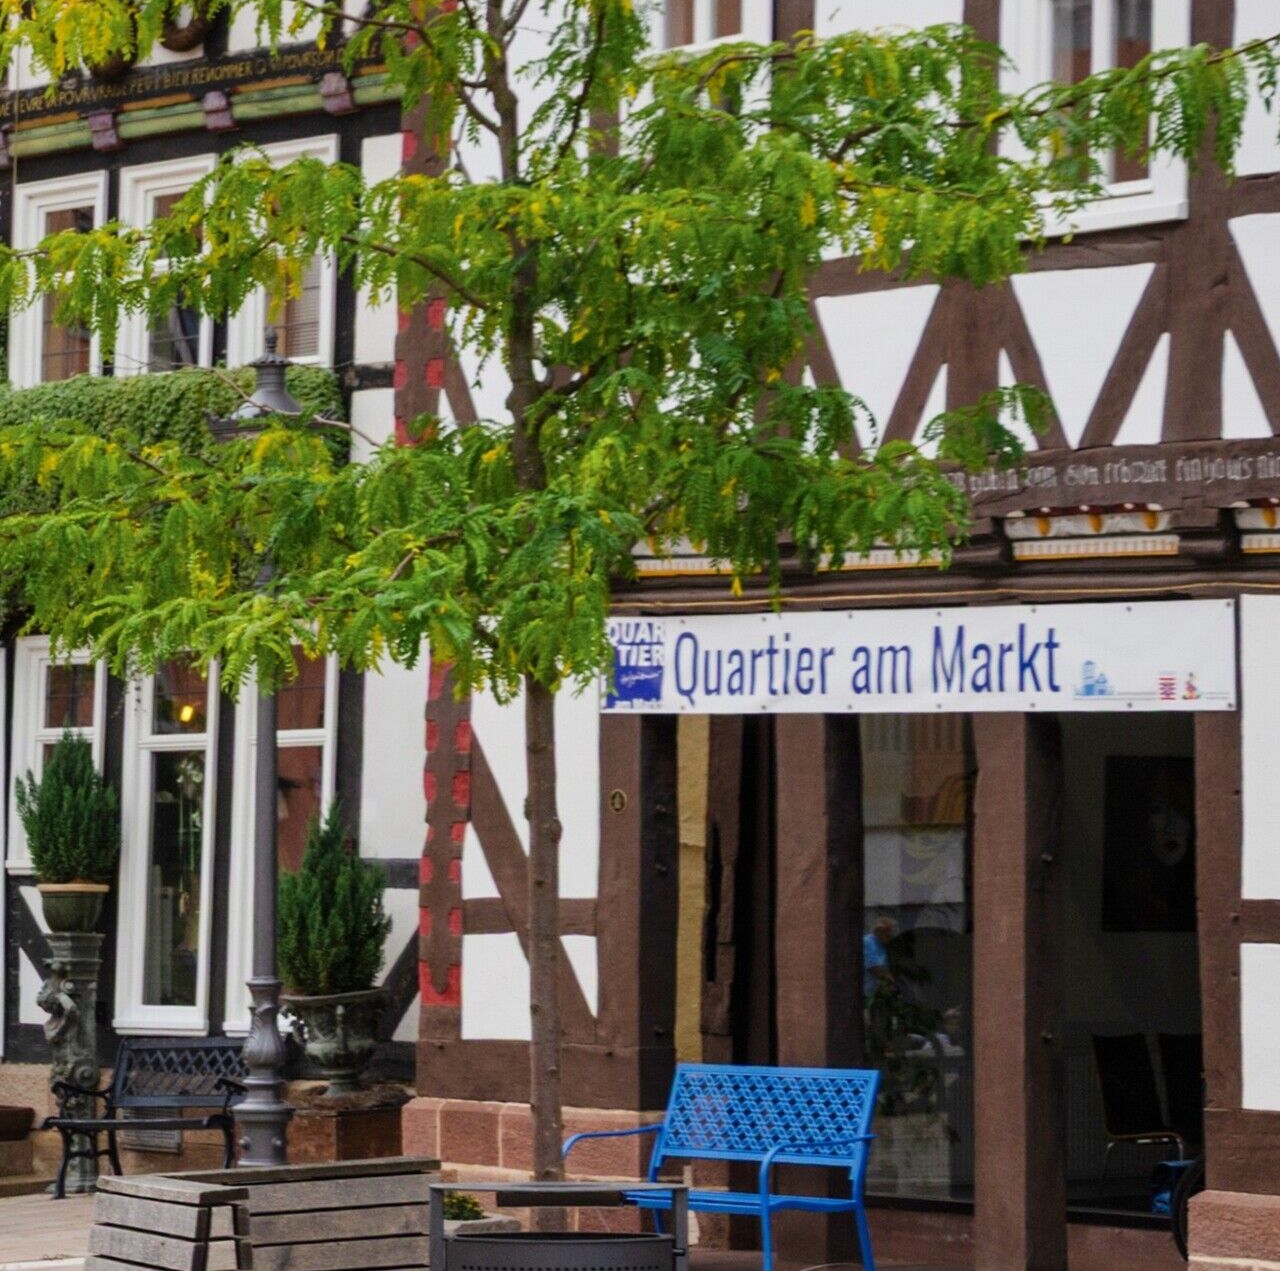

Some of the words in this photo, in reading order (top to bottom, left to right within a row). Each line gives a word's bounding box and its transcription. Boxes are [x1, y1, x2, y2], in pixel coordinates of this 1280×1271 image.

[673, 631, 835, 706] Quartier
[851, 643, 913, 696] am
[931, 622, 1061, 694] Markt
